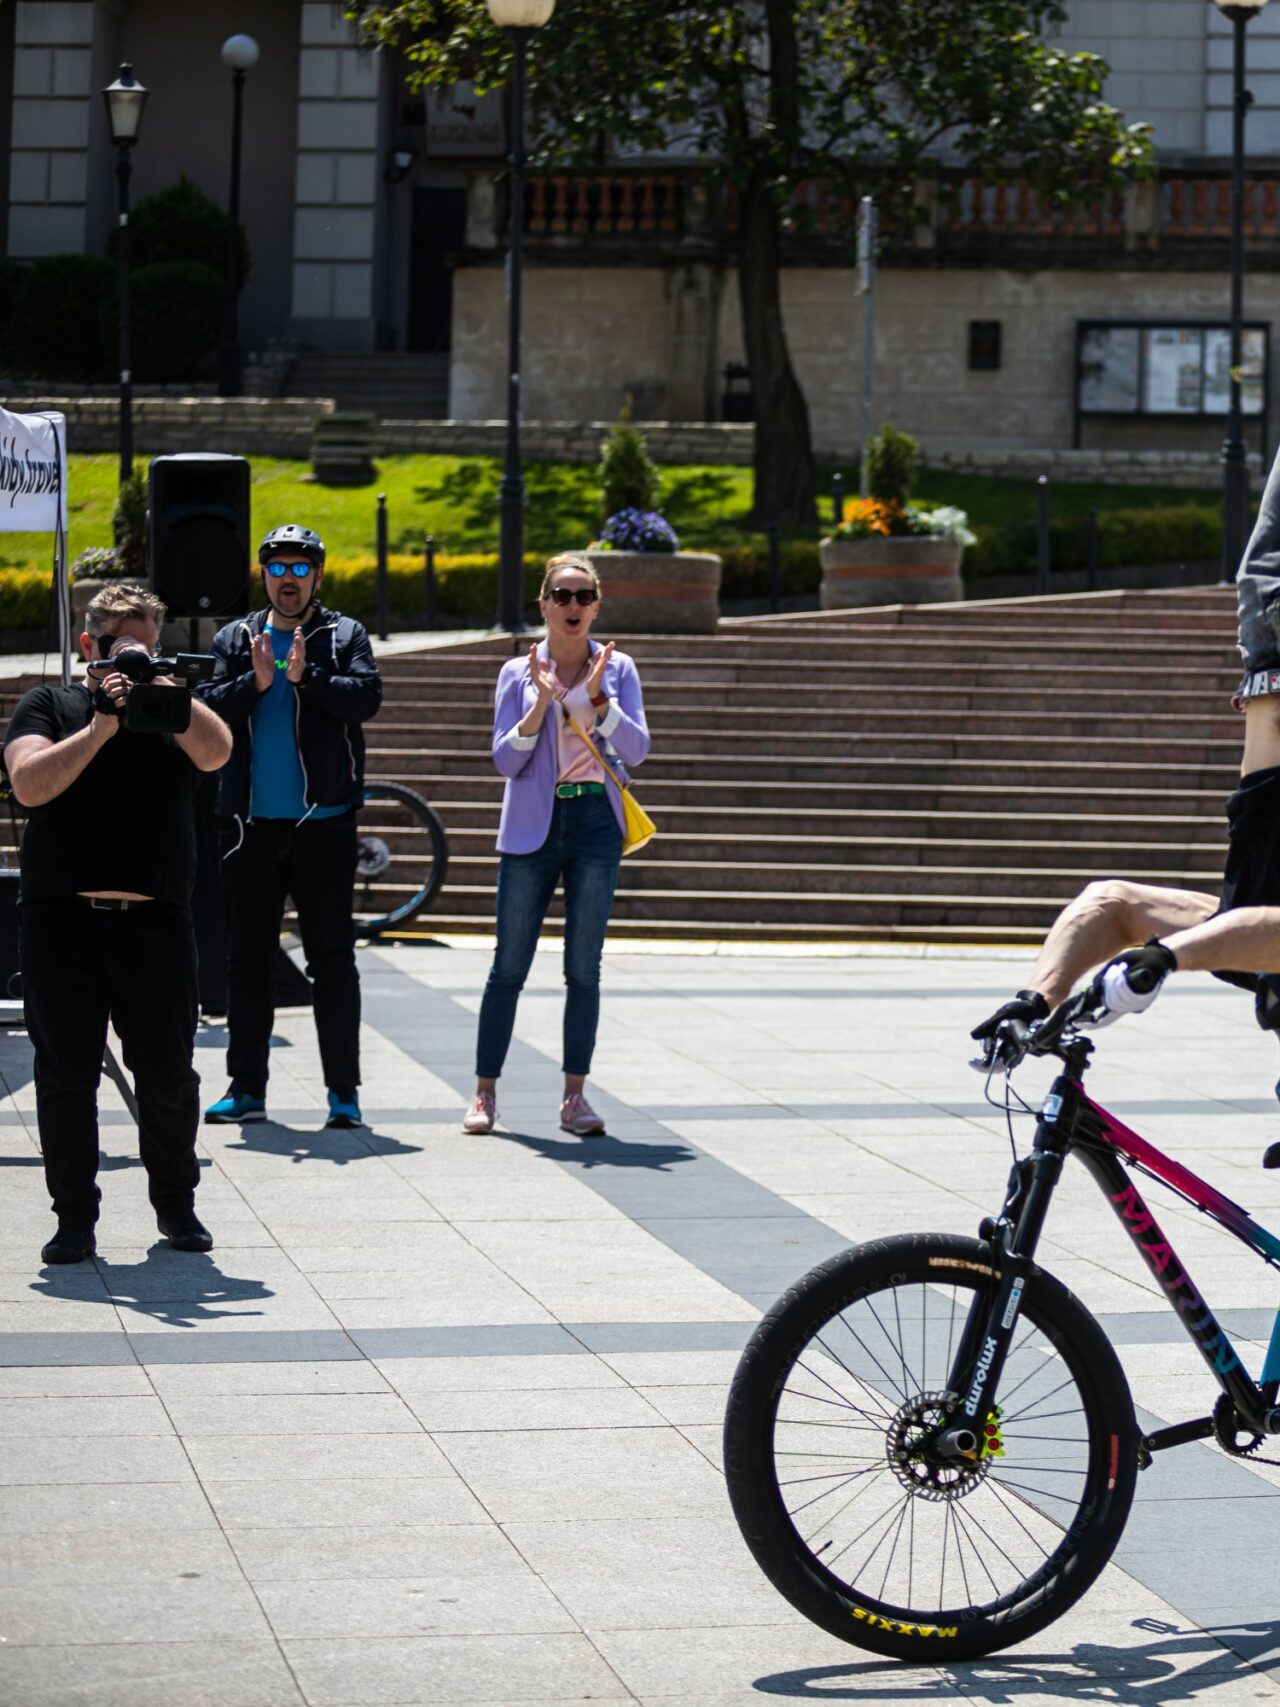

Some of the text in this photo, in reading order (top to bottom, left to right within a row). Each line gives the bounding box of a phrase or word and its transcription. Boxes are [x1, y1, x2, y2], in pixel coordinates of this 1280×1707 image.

[1111, 1183, 1240, 1375] MARIN
[965, 1336, 998, 1417] durolux
[851, 1607, 959, 1638] MAXXIS
